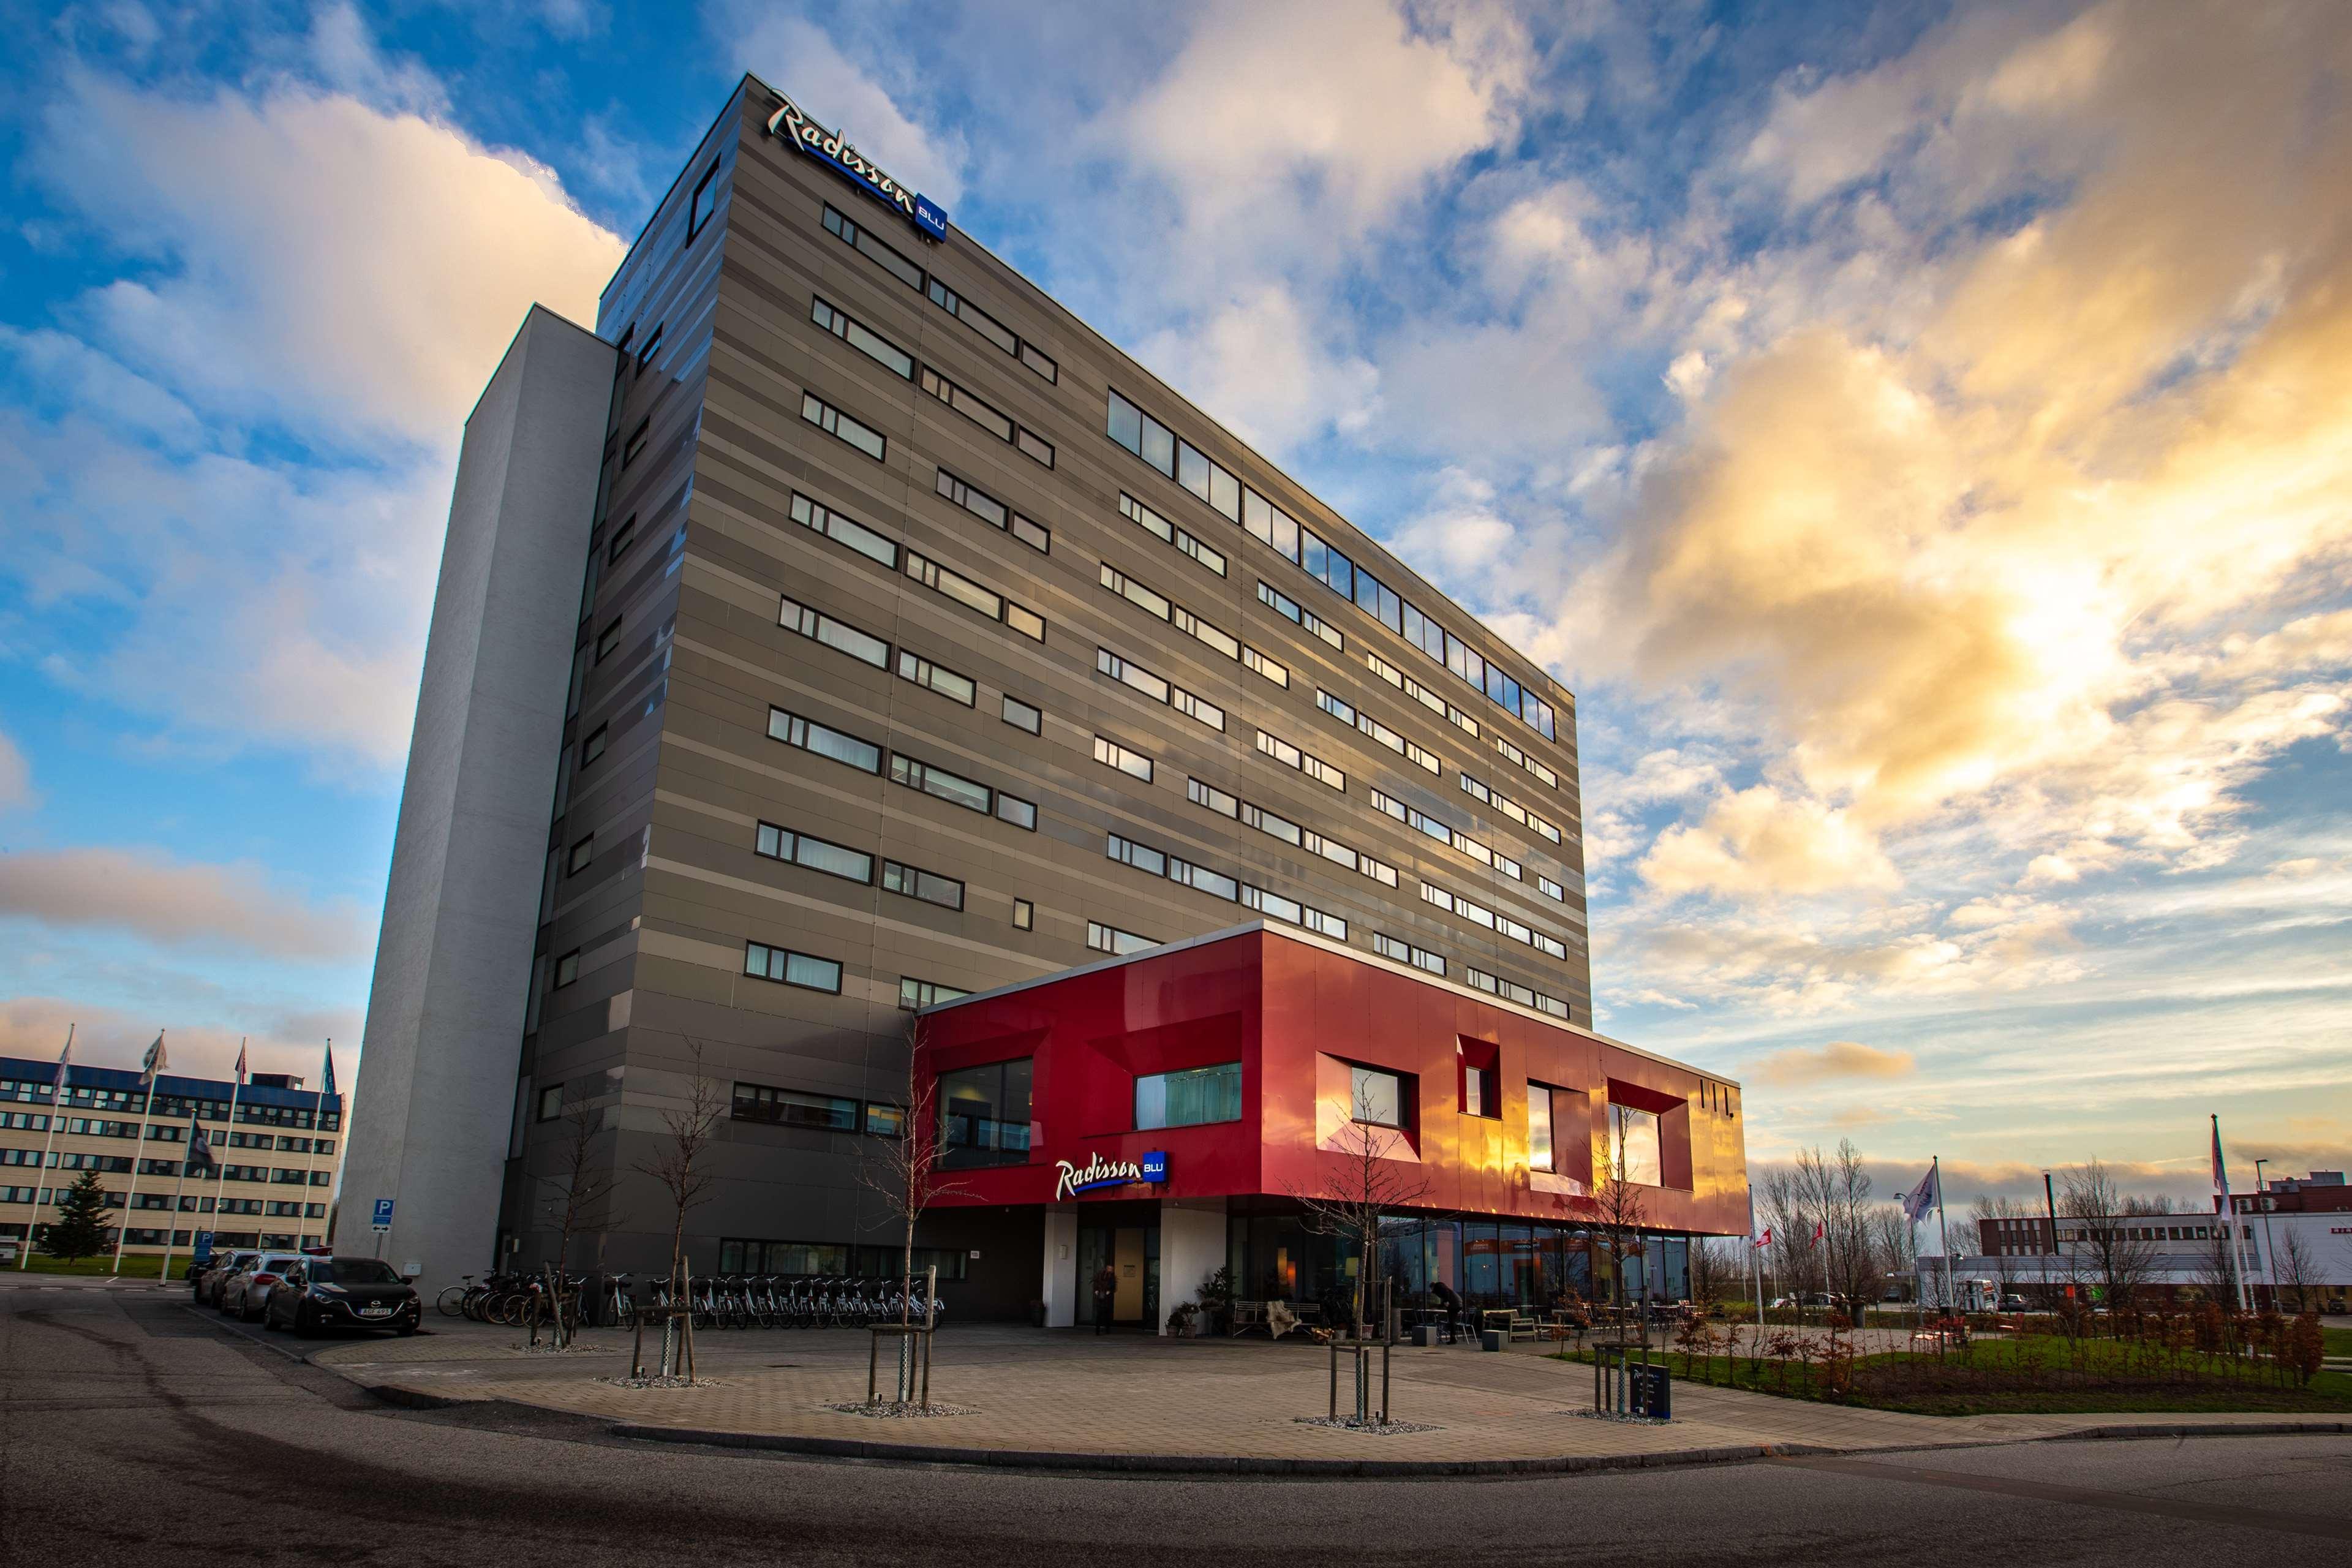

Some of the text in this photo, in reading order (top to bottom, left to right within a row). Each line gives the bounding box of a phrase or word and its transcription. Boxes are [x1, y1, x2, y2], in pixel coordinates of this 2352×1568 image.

[768, 89, 944, 230] Radisson BLU
[1055, 1152, 1163, 1201] Radisson BLU
[379, 1200, 391, 1214] P
[202, 1233, 211, 1243] P
